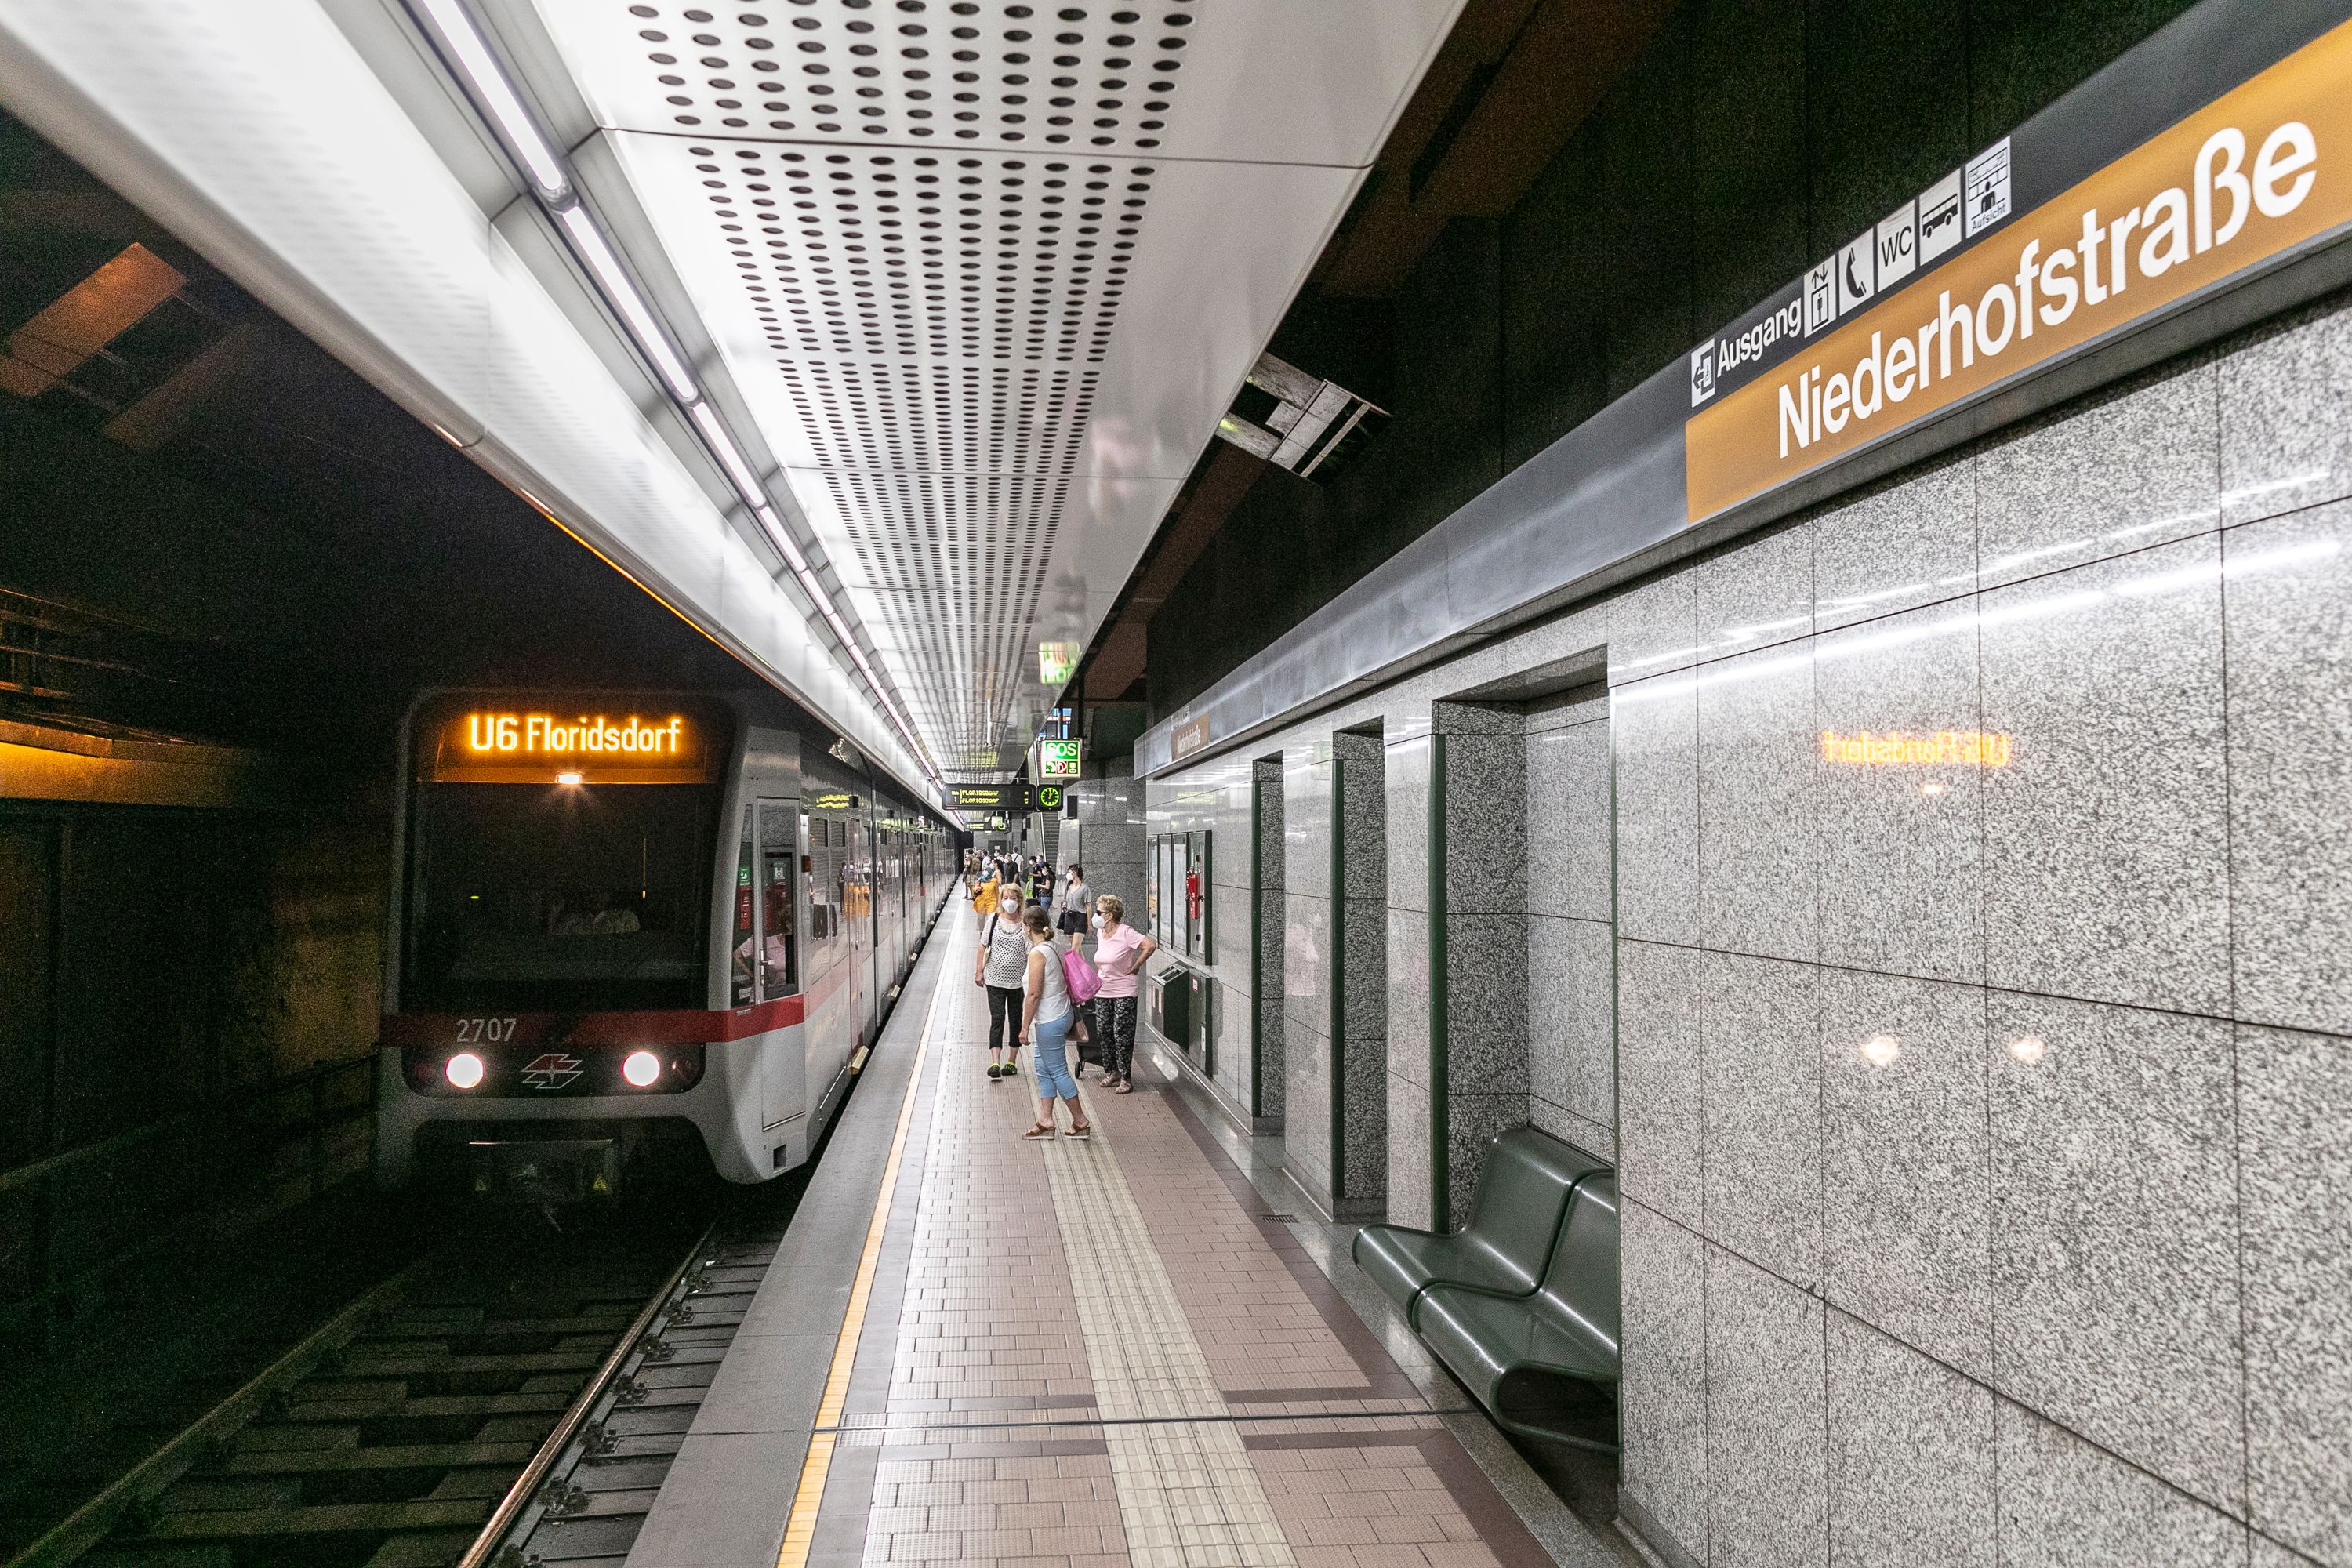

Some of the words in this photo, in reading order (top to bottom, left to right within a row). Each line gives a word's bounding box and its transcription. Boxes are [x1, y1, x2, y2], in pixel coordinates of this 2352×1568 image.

[1971, 203, 2005, 231] Aufsicht
[1881, 225, 1913, 267] WC
[1779, 122, 2317, 459] Niederhofstraße
[1717, 298, 1801, 378] Ausgang
[470, 716, 518, 750] U6
[527, 716, 681, 751] Floridsdorf
[1046, 742, 1077, 757] SOS
[457, 1019, 517, 1043] 2707
